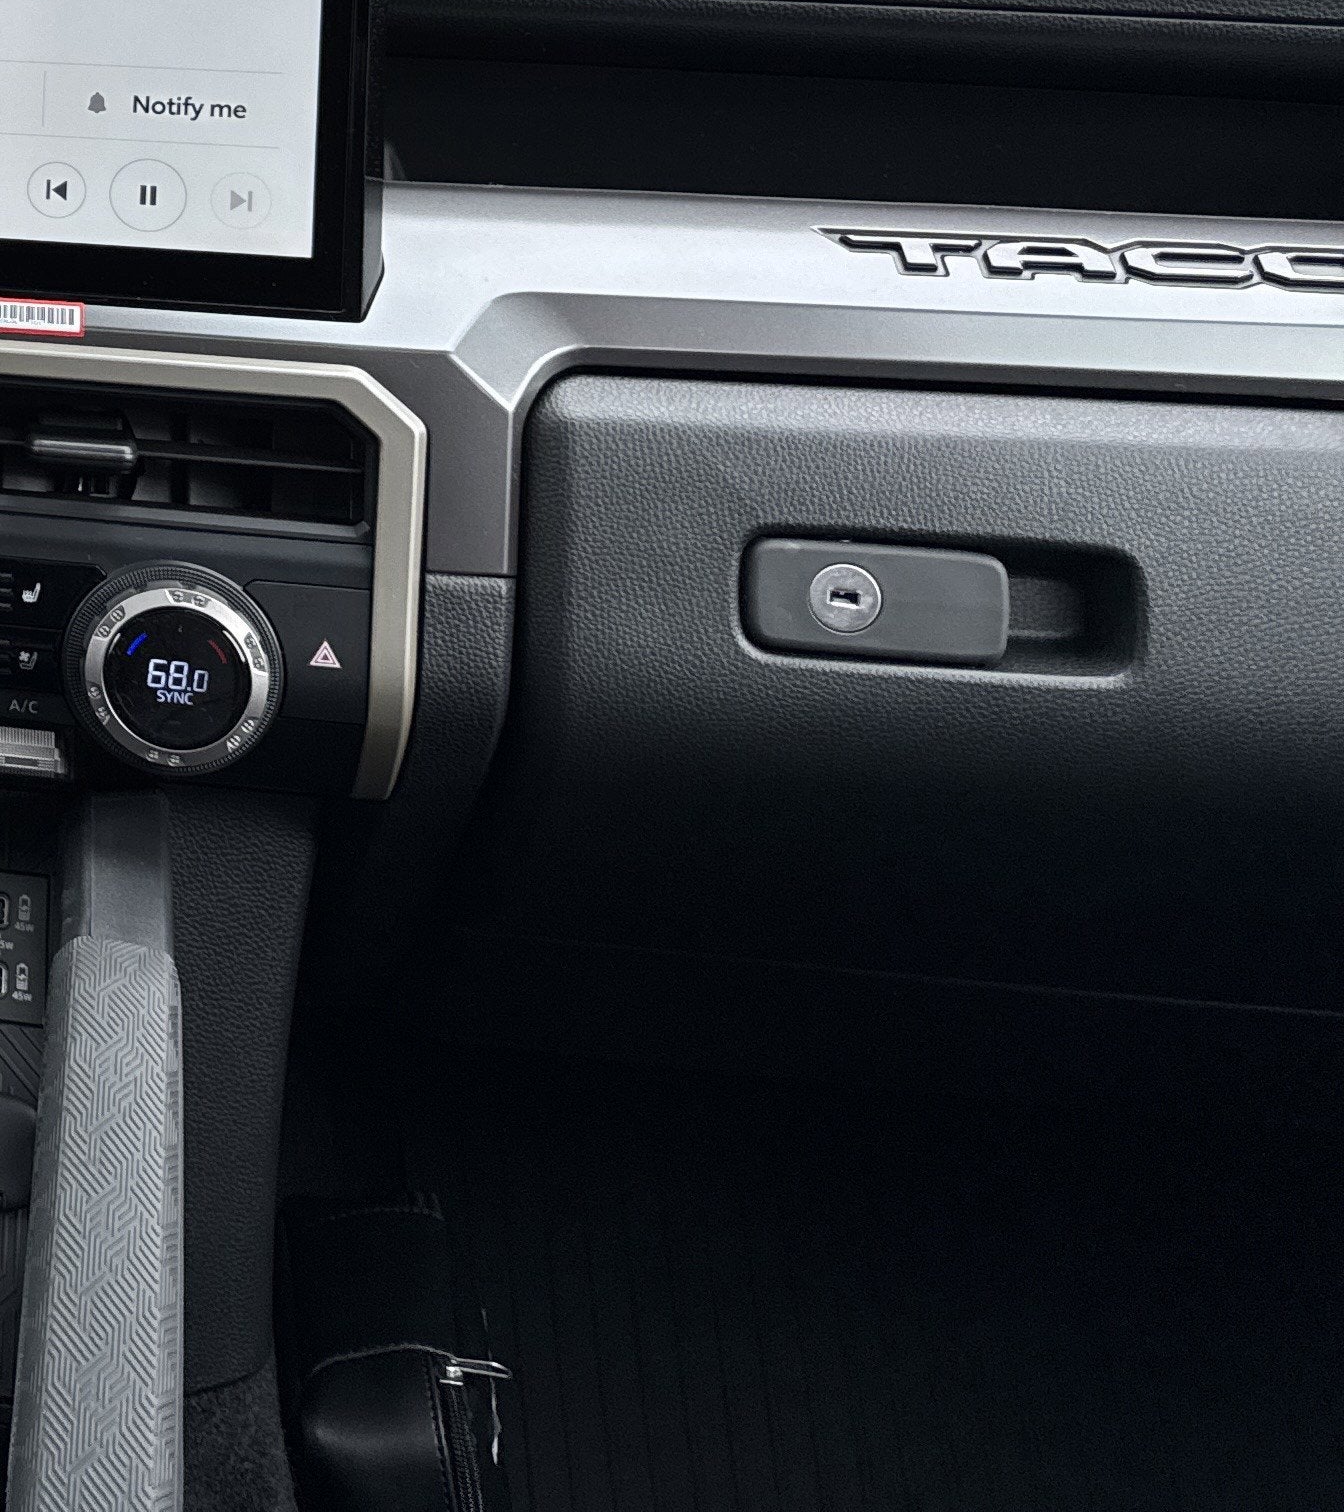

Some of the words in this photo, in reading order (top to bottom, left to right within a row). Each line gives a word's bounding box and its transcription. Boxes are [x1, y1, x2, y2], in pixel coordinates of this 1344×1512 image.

[131, 94, 204, 120] Notify
[209, 101, 247, 119] me
[147, 659, 209, 694] 68.0
[9, 698, 39, 715] A/C
[156, 689, 194, 707] SYNC
[14, 922, 35, 933] 45W
[11, 990, 33, 1002] 45W
